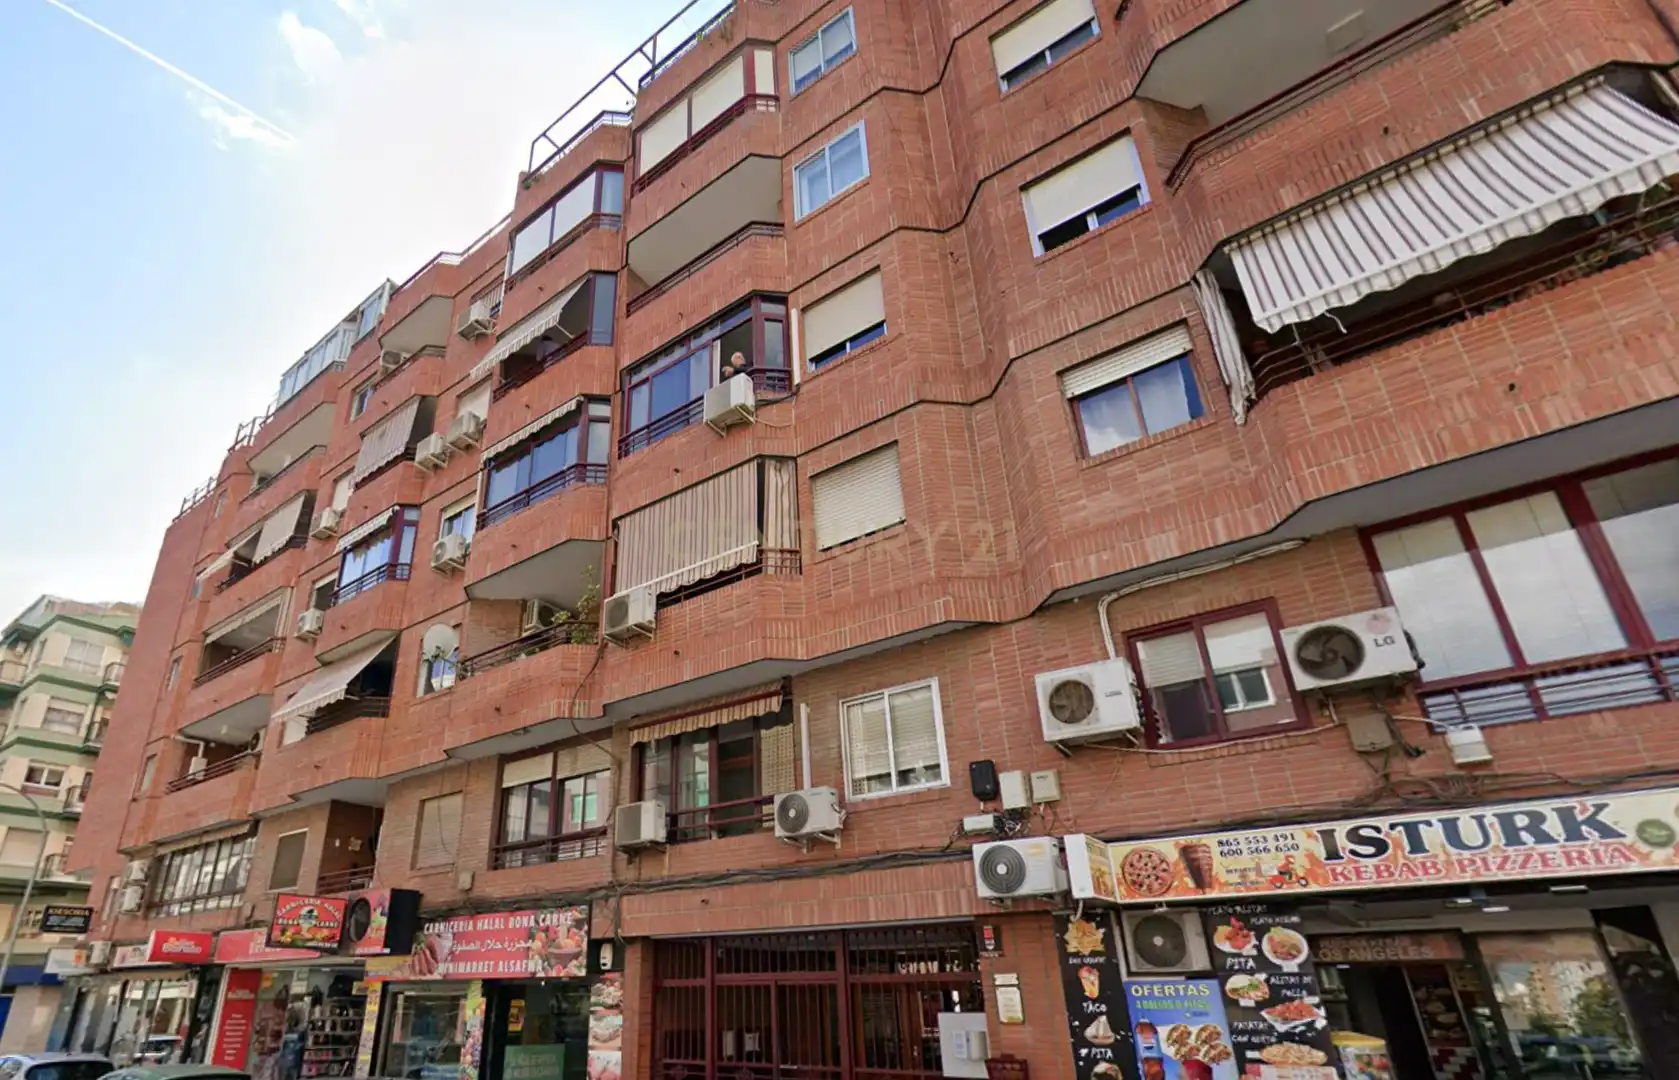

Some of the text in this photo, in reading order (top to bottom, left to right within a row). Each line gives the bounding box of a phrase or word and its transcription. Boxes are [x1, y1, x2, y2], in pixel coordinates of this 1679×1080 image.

[1374, 635, 1396, 647] LG
[1316, 803, 1628, 861] ISTURK
[1330, 844, 1635, 882] KEBAB PIZZERIA
[424, 911, 573, 935] CARNICERIA HALAL BONA CARNE
[1348, 945, 1435, 961] ANGELES
[1226, 957, 1257, 970] PITA
[1131, 984, 1211, 997] OFERTAS
[1082, 1001, 1107, 1013] TACO
[1091, 1048, 1114, 1060] PITA
